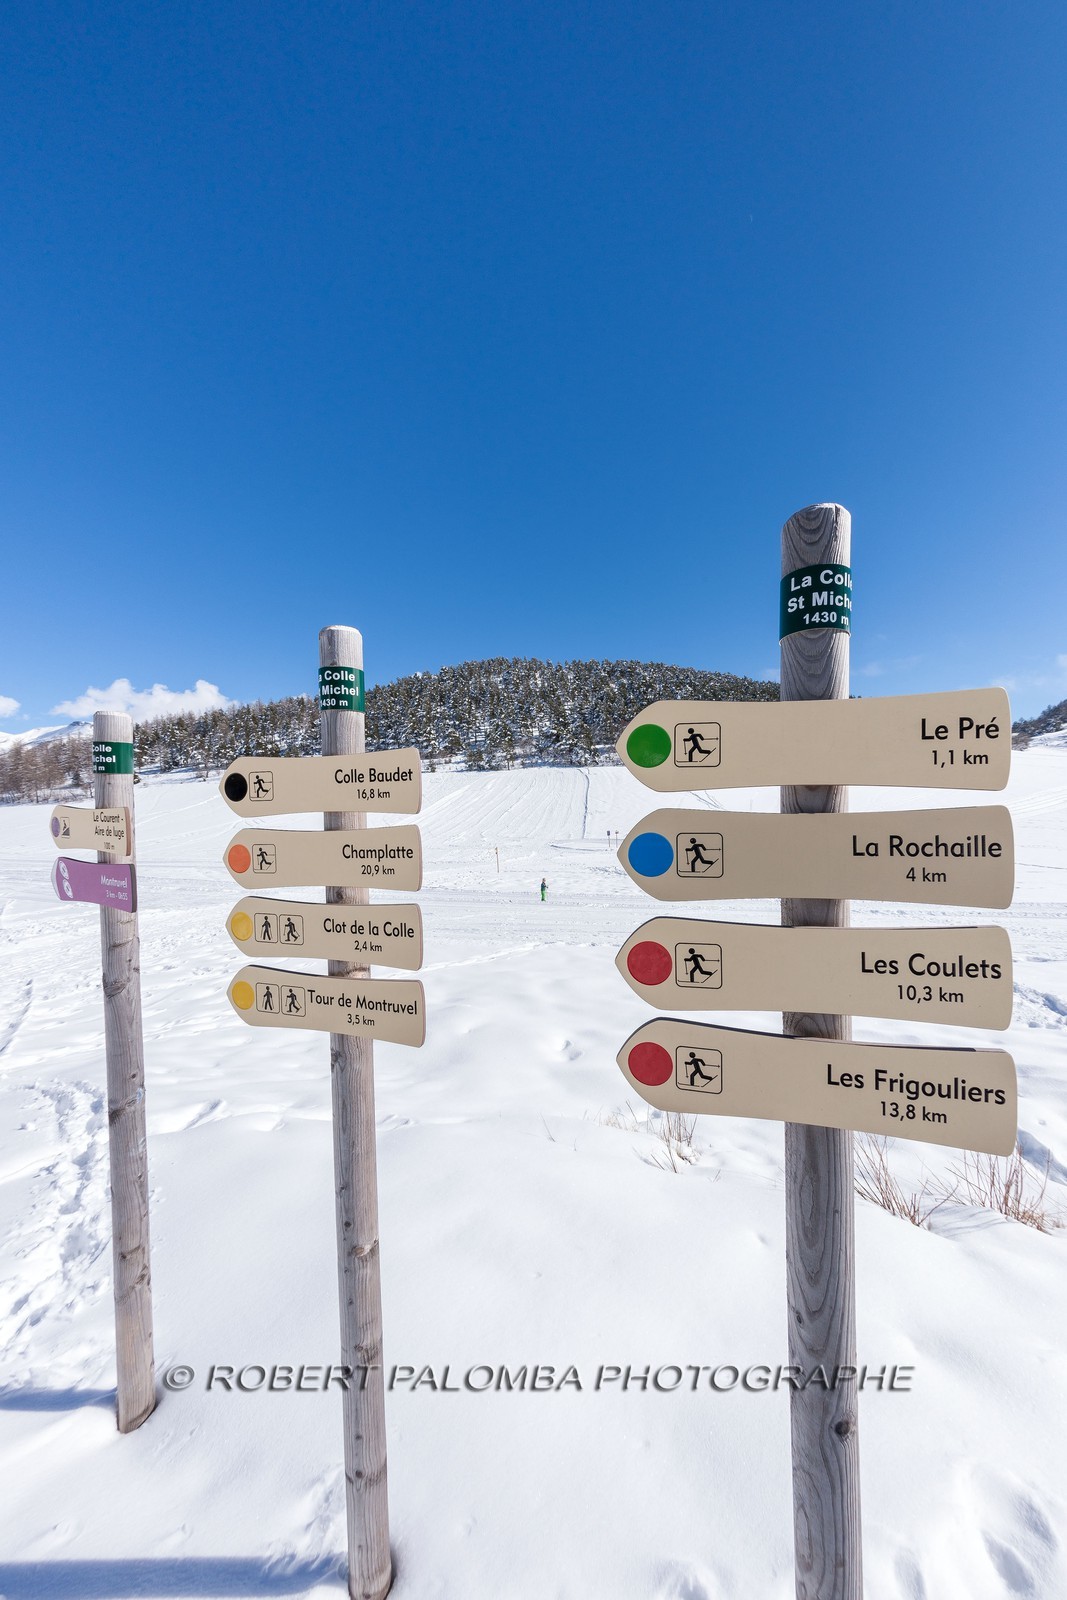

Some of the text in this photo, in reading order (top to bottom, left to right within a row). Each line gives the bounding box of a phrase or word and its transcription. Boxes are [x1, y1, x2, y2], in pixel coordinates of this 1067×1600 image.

[790, 576, 812, 592] La
[788, 596, 804, 612] St
[803, 612, 848, 626] 1430 m
[324, 670, 355, 682] Colle
[322, 684, 358, 696] Michel
[920, 717, 1000, 740] Le Pré
[932, 750, 989, 768] 1,1 km
[334, 767, 413, 784] Colle Baudet
[357, 788, 390, 800] 16,8 km
[93, 812, 99, 822] Le
[94, 826, 124, 840] Aire de luge
[342, 844, 414, 862] Champlatte
[852, 834, 1002, 858] La Rochaille
[361, 865, 395, 876] 20,9 km
[906, 867, 947, 882] 4 km
[323, 918, 414, 938] Clot de la Colle
[354, 940, 382, 952] 2,4 km
[860, 952, 1002, 979] Les Coulets
[307, 990, 418, 1015] Tour de Montruvel
[898, 985, 964, 1004] 10,3 km
[347, 1014, 375, 1026] 3,5 km
[827, 1064, 1006, 1105] Les Frigouliers
[880, 1101, 948, 1124] 13,8 km
